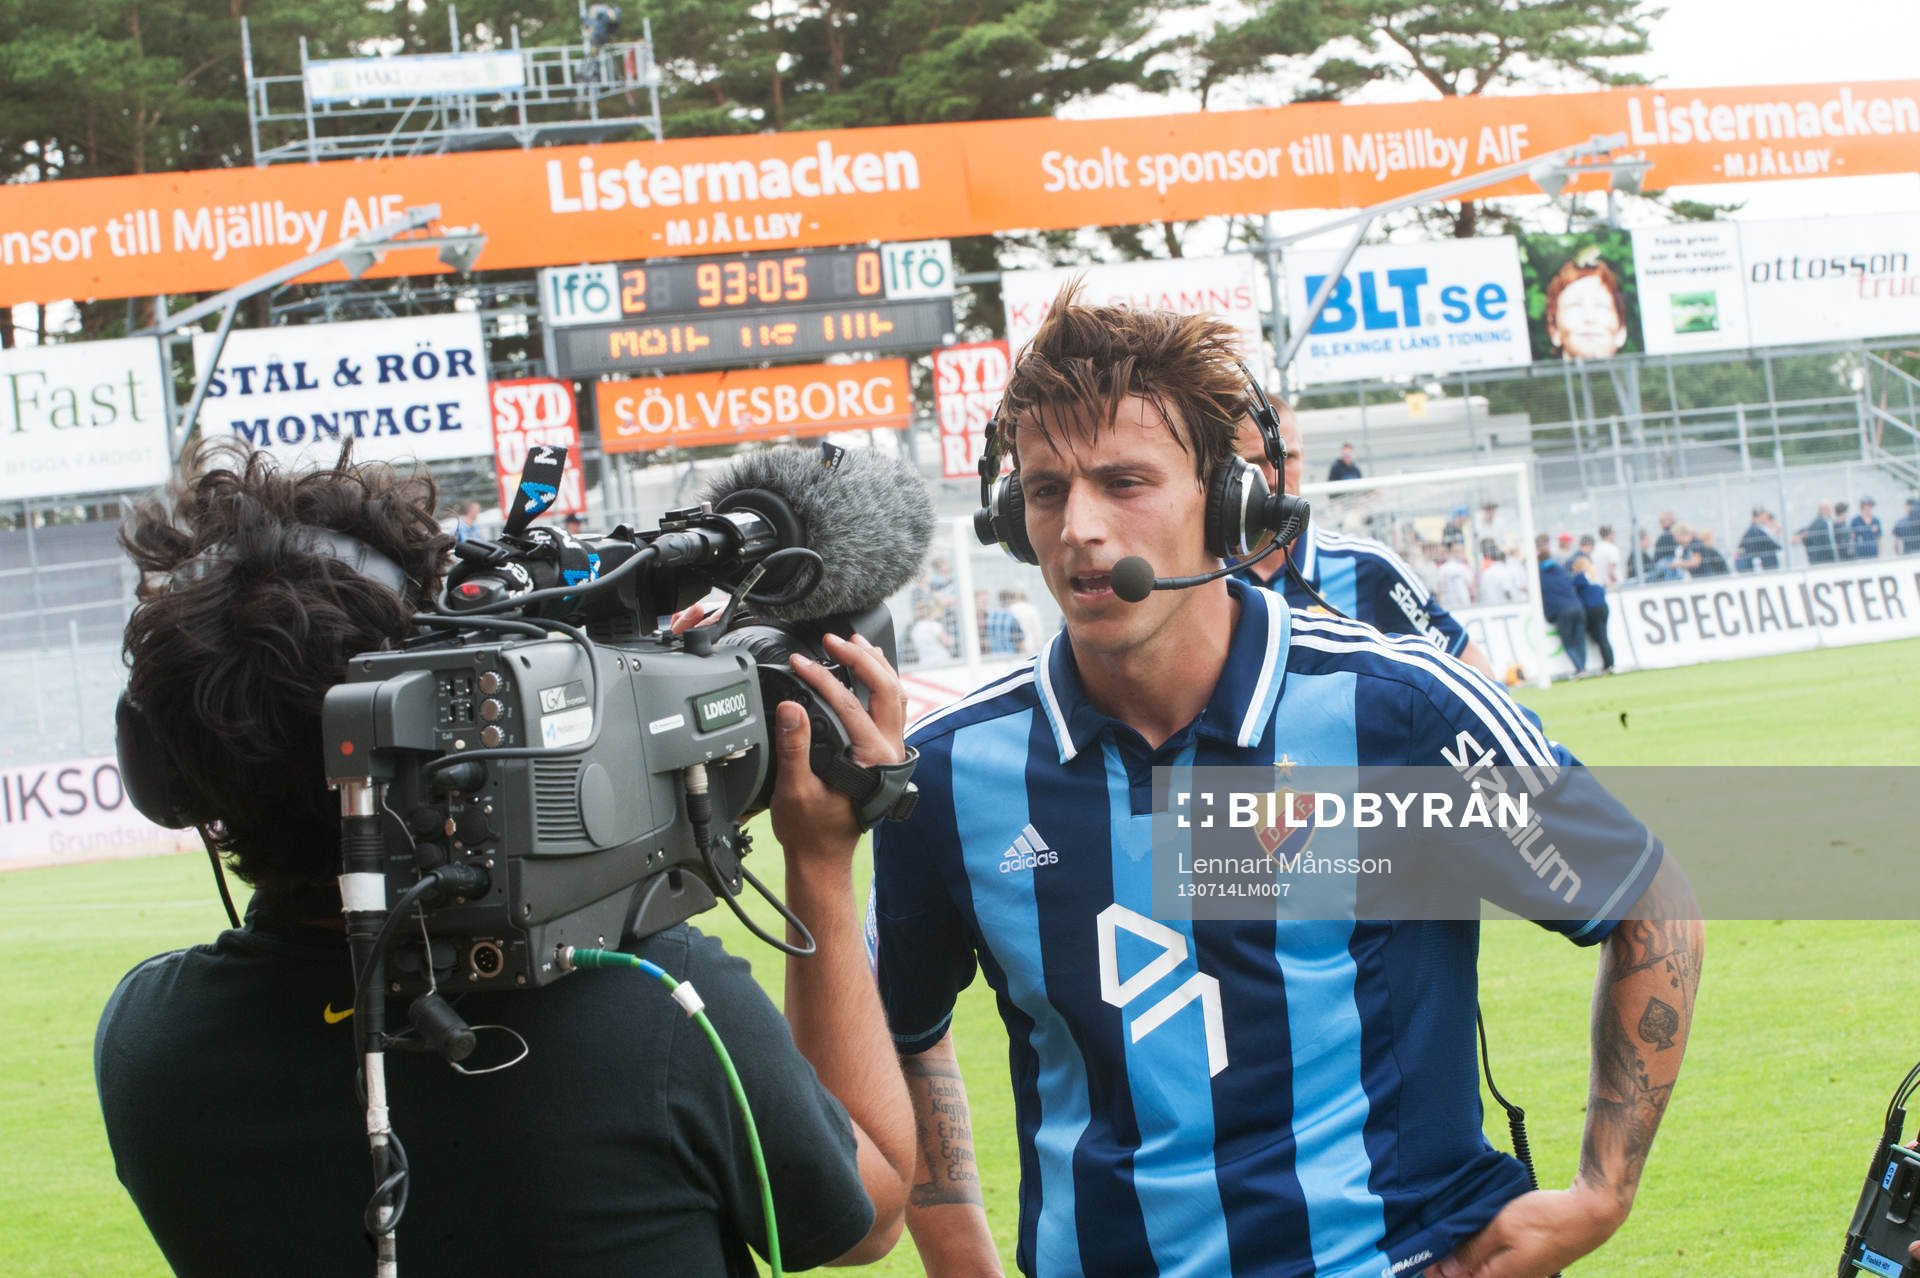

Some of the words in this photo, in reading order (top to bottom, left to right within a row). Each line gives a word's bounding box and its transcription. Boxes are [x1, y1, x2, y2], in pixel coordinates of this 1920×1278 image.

[1627, 88, 1920, 147] Listermacken
[546, 141, 919, 214] Listermacken
[1041, 146, 1130, 193] Stolt
[1137, 146, 1282, 194] sponsor
[1288, 133, 1335, 177] till
[1342, 127, 1467, 182] Mjällby
[1477, 124, 1530, 166] AIF
[0, 225, 97, 266] nsor
[106, 207, 162, 257] till
[173, 200, 328, 261] Mjällby
[338, 194, 404, 240] AIF
[551, 270, 611, 317] Ifö
[622, 268, 648, 314] 2
[697, 256, 809, 307] 93:05
[856, 251, 882, 296] 0
[888, 248, 946, 290] Ifö
[1751, 252, 1909, 284] ottosson
[332, 357, 363, 388] &
[376, 340, 477, 384] RÖR
[1309, 338, 1393, 359] BLEKINGE
[1449, 328, 1513, 349] TIDNING
[937, 346, 1009, 395] SYD
[5, 368, 148, 434] Fast
[230, 401, 463, 447] MONTAGE
[492, 381, 573, 433] SYD
[613, 376, 896, 437] SÖLVESBORG
[1639, 575, 1907, 646] SPECIALISTER
[703, 692, 747, 721] LDK8000
[2, 763, 124, 823] IKSO
[998, 850, 1060, 874] adidas
